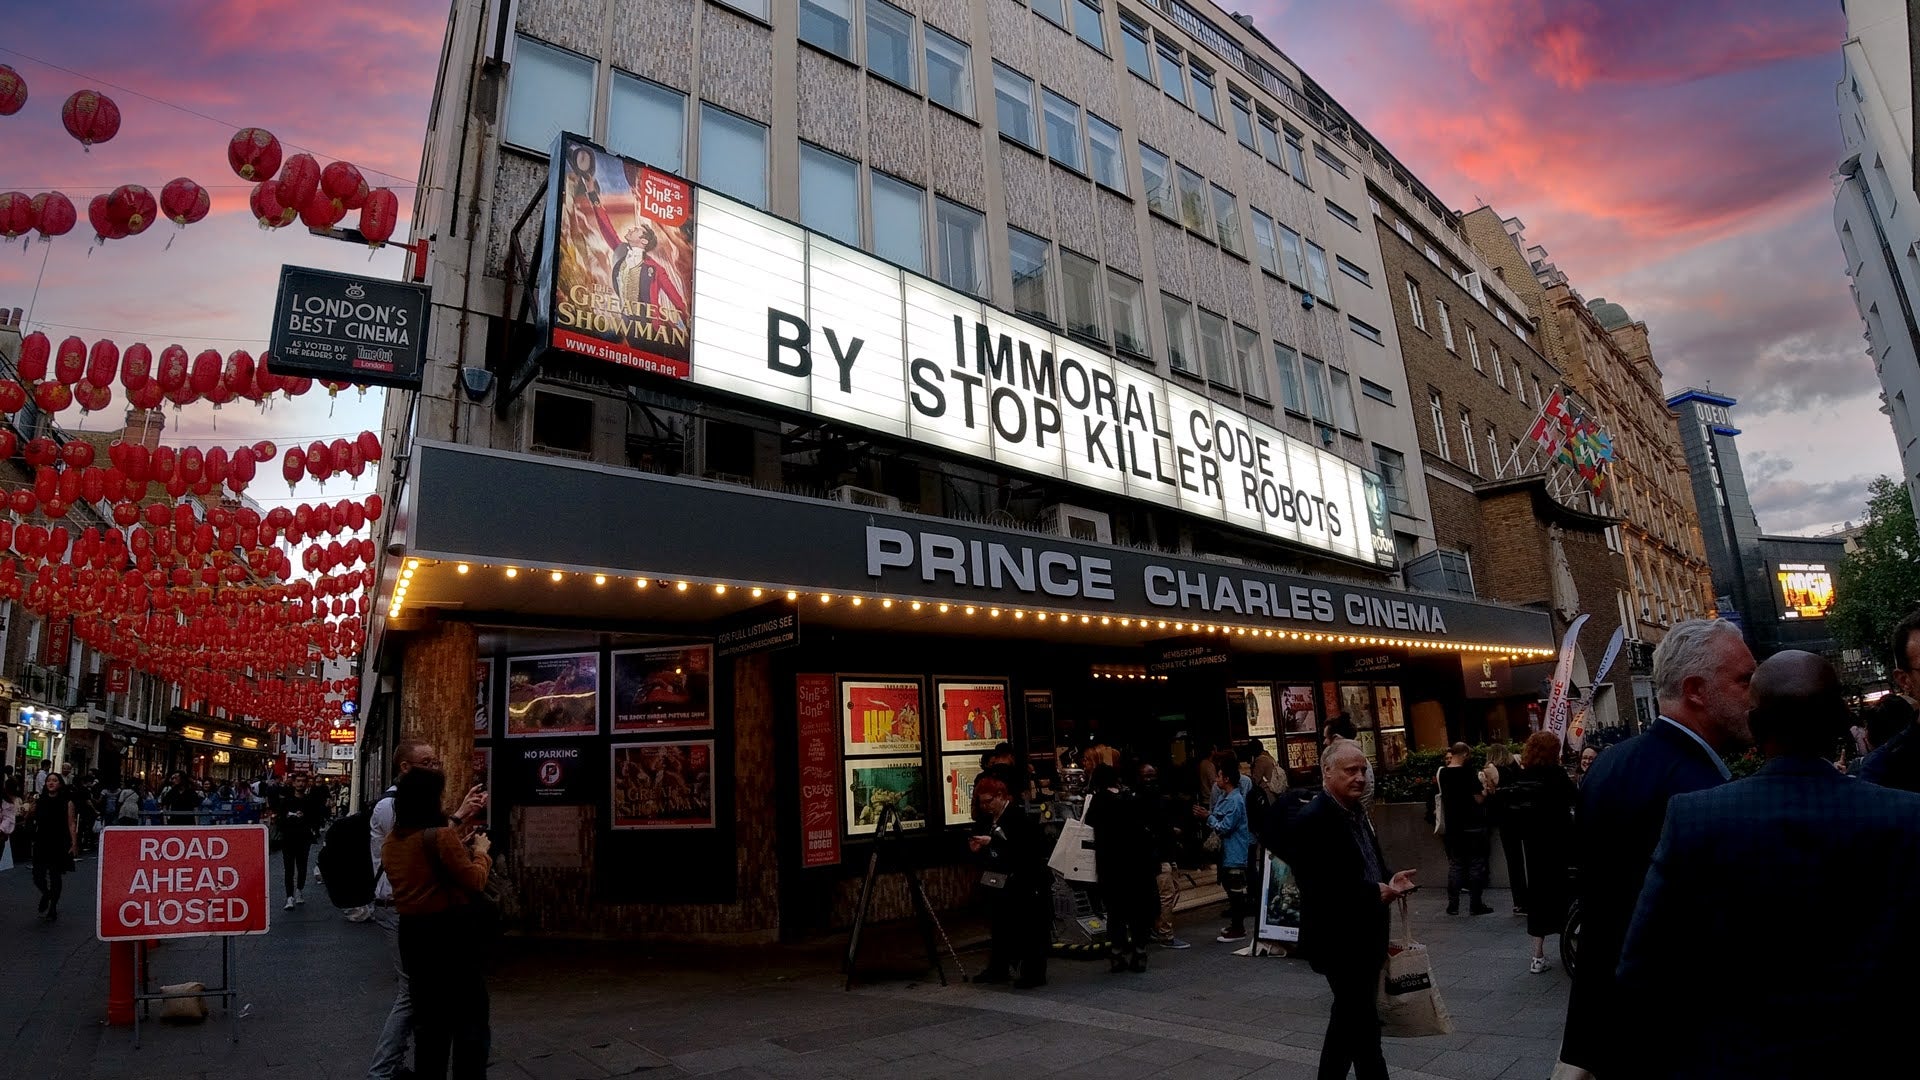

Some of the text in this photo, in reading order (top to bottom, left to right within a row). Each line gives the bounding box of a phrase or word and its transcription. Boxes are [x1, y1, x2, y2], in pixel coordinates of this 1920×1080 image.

[292, 293, 408, 327] LONDON'S
[570, 285, 684, 323] GREATEST
[290, 314, 410, 345] BEST CINEMA
[558, 302, 687, 347] SHOWMAN
[285, 346, 348, 361] THE READERS OF
[304, 342, 331, 351] VOTED
[566, 337, 678, 378] www.singalonga.net
[361, 361, 386, 370] London
[954, 313, 1275, 477] IMMORAL CODE
[768, 306, 1343, 538] BY STOP KILLER ROBOTS
[866, 525, 1448, 635] PRINCE CHARLES CINEMA
[718, 614, 794, 645] FOR FULL LISTINGS SEE
[1150, 653, 1228, 673] CINEMATIC HAPPINESS
[1162, 646, 1204, 660] MEMBERSHIP
[524, 749, 579, 760] NO PARKING
[140, 837, 229, 861] ROAD
[128, 867, 240, 894] AHEAD
[118, 897, 250, 928] CLOSED
